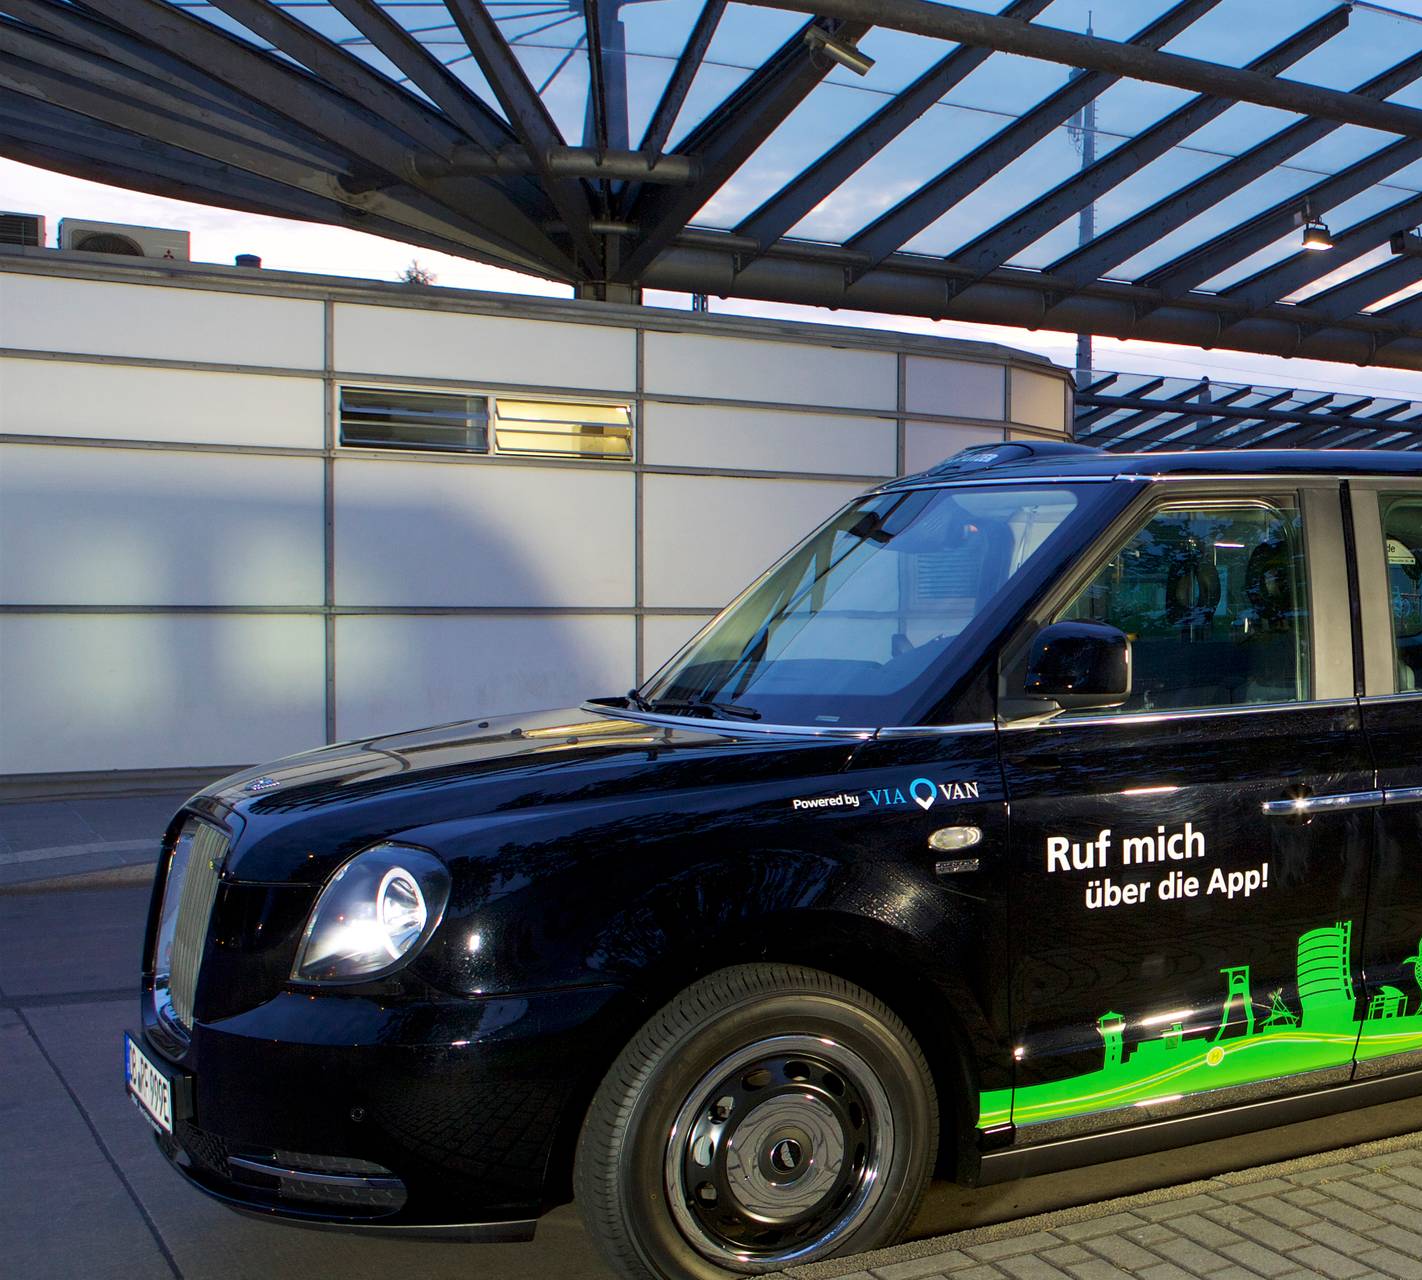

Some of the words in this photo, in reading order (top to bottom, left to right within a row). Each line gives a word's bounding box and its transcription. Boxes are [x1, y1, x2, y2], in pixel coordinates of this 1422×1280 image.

[793, 794, 844, 809] Powered
[844, 793, 860, 808] by
[867, 788, 907, 806] VIA
[939, 782, 981, 800] VAN
[1047, 829, 1112, 873] Ruf
[1122, 822, 1206, 865] mich
[1085, 878, 1150, 909] über
[1158, 871, 1199, 900] die
[1206, 862, 1269, 899] App!
